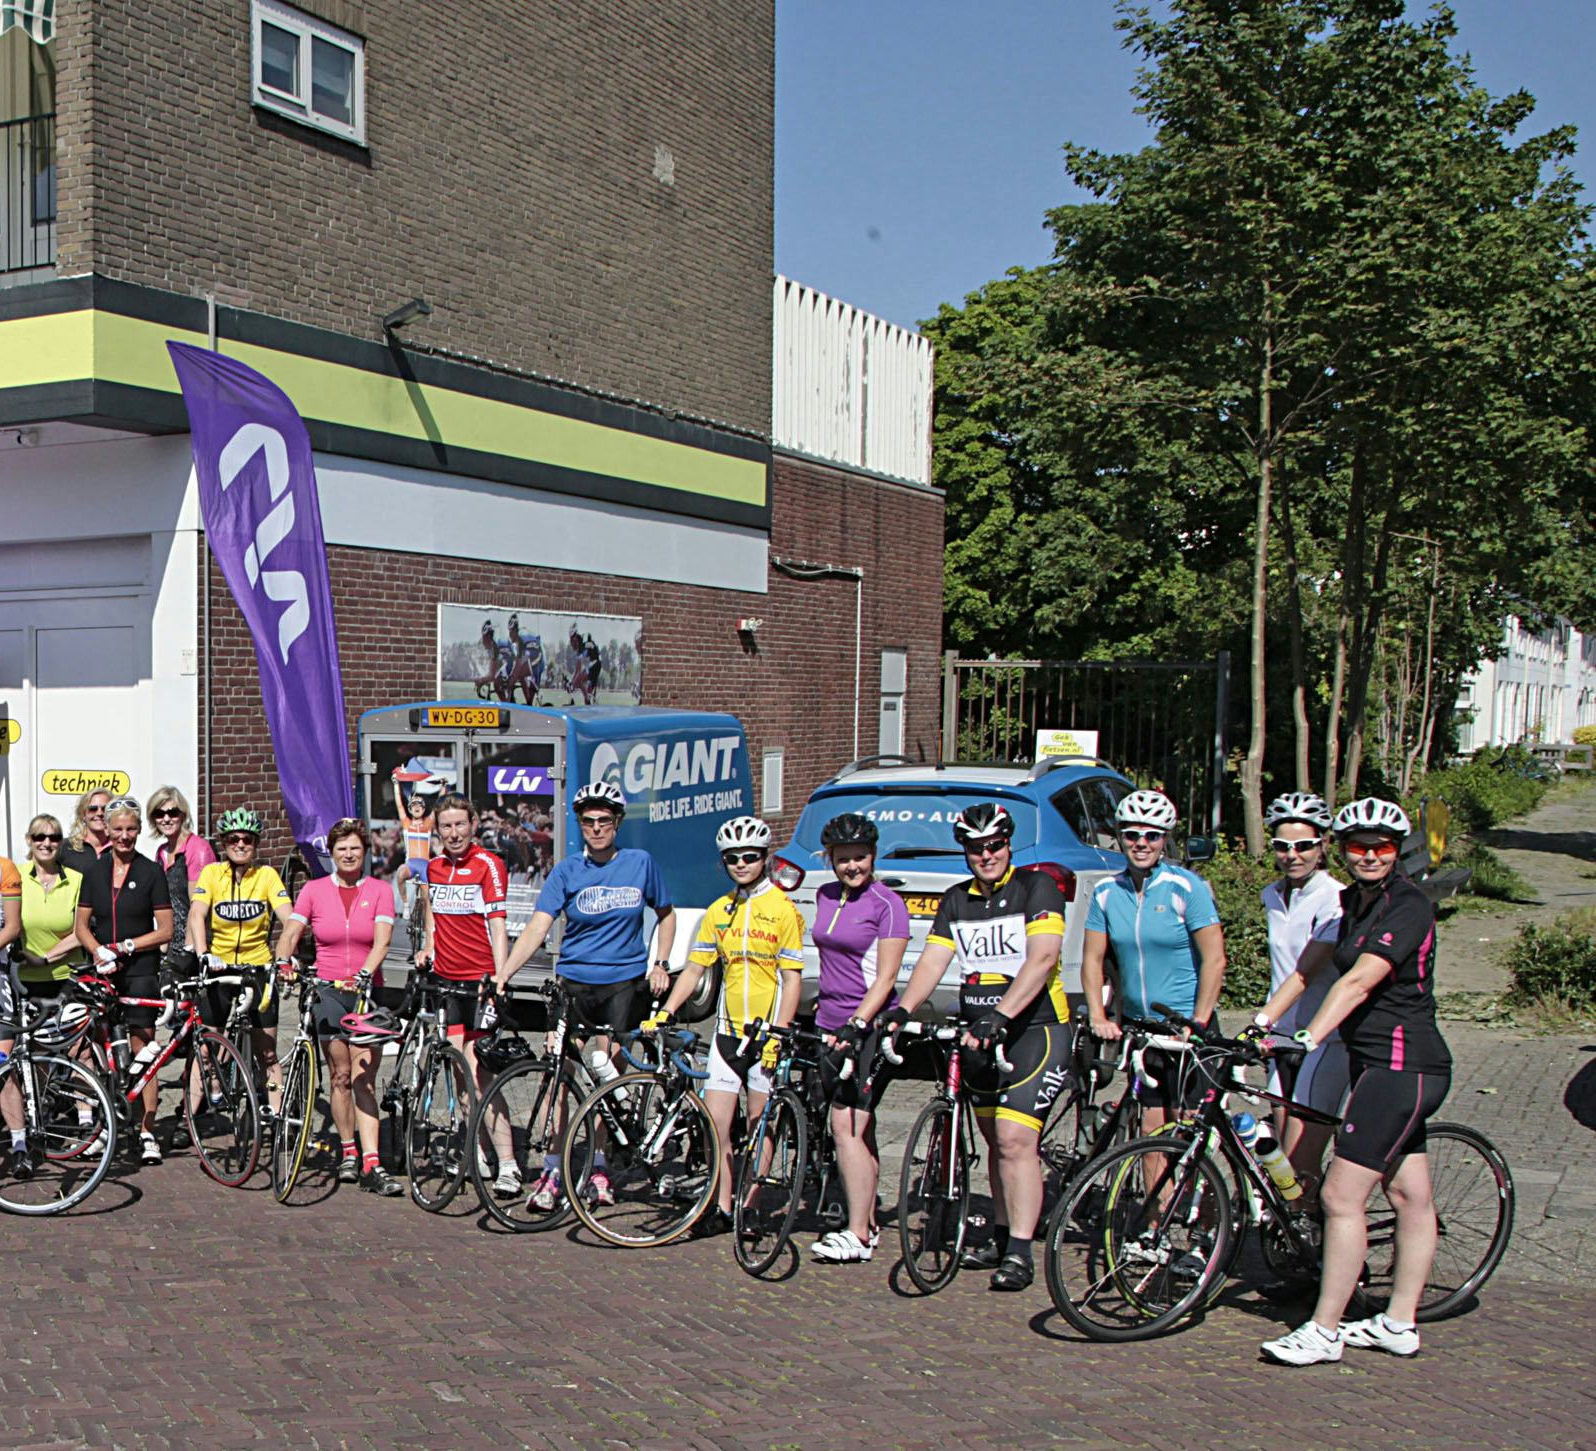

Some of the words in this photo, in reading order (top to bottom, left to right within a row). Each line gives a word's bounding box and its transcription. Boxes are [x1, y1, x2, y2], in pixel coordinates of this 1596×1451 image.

[432, 711, 495, 724] WV-DG-30
[624, 736, 740, 794] GIANT
[52, 772, 120, 793] techniek
[493, 769, 542, 792] Liv
[649, 800, 671, 823] RIDE
[672, 797, 693, 819] LIFE.
[694, 793, 714, 815] RIDE
[715, 789, 743, 812] GIANT.
[435, 900, 475, 909] CONTROL
[436, 886, 475, 901] BIKE
[219, 903, 260, 919] BORETTI
[956, 924, 1021, 958] Valk
[1034, 1065, 1068, 1111] Valk
